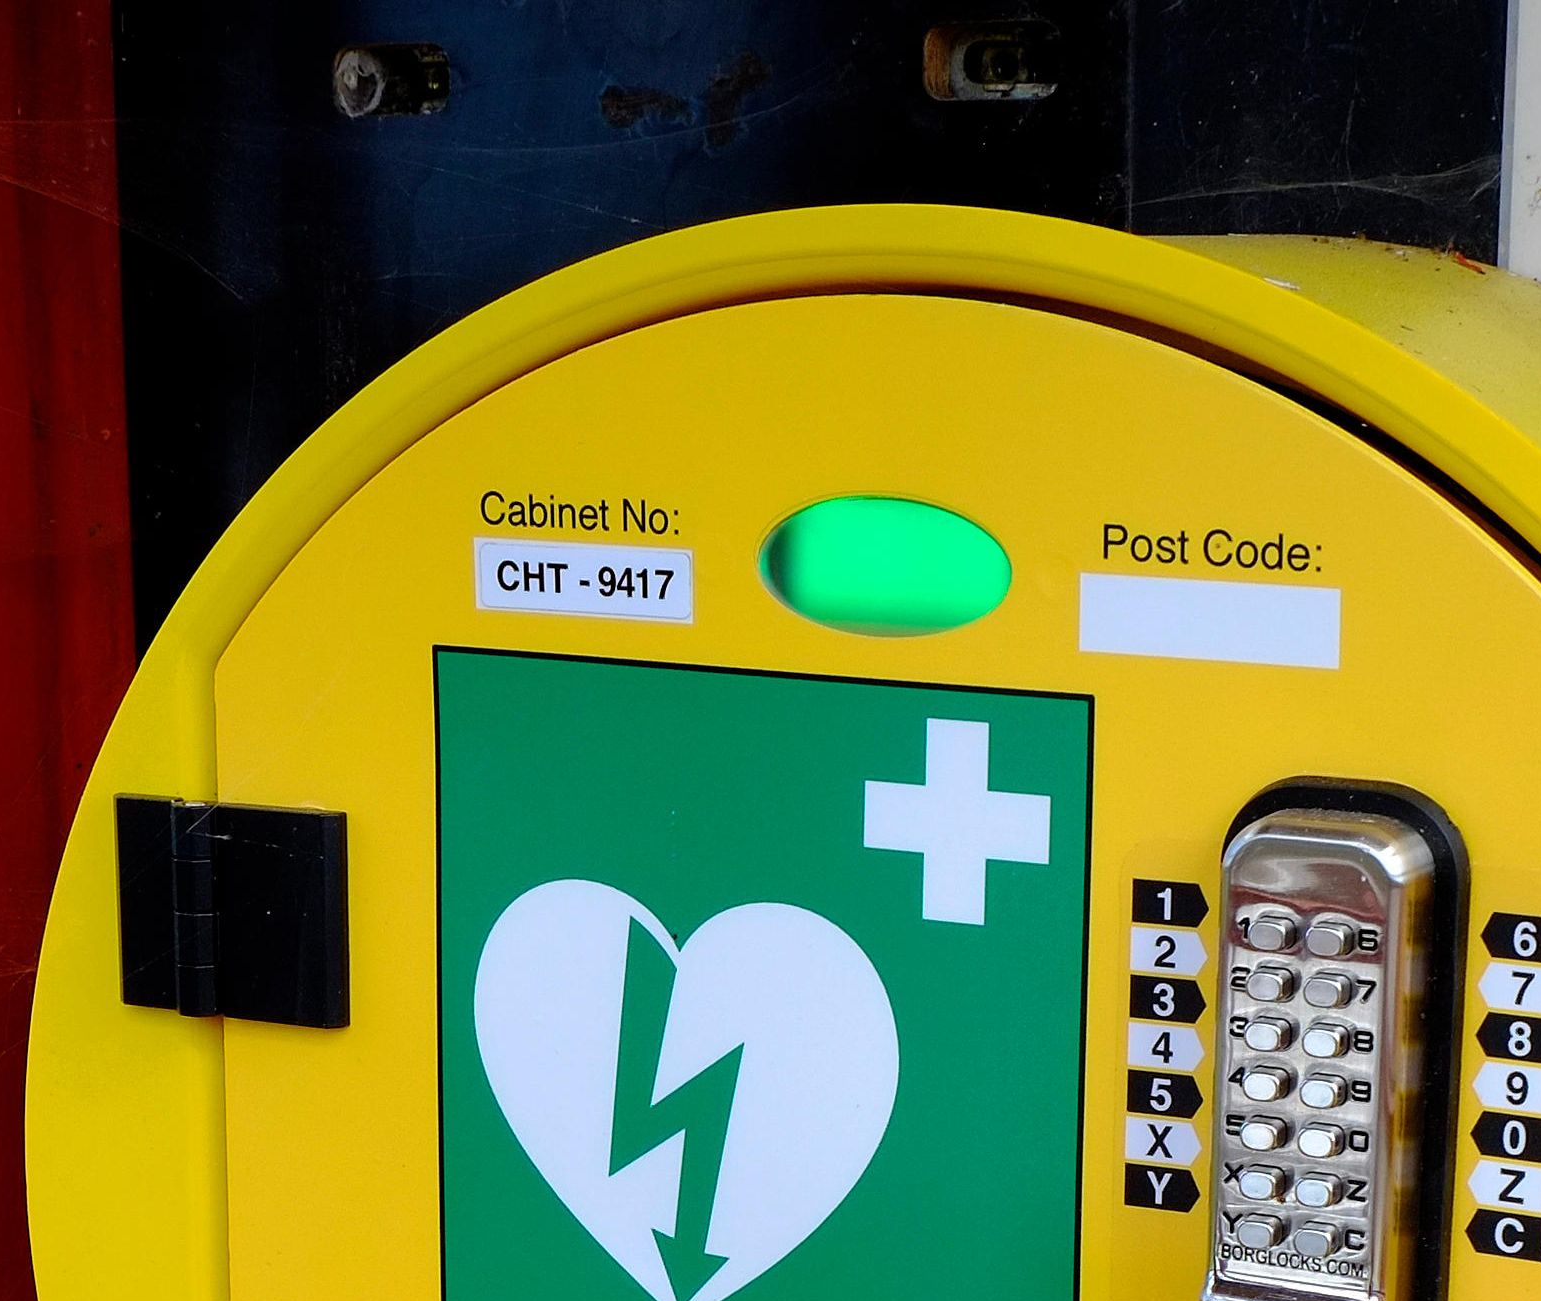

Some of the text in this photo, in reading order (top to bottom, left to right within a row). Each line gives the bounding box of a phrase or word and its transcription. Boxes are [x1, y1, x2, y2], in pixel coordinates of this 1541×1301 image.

[480, 493, 681, 536] Cabinet No:
[1103, 524, 1324, 573] Post Code:
[496, 561, 567, 596] CHT
[598, 566, 674, 600] 9417
[1158, 888, 1172, 920] 1
[1238, 917, 1250, 939] 1
[1358, 928, 1378, 951] 6
[1513, 922, 1537, 957] 6
[1154, 936, 1175, 968] 2
[1231, 966, 1250, 989] 2
[1355, 979, 1377, 1003] 7
[1512, 972, 1535, 1006] 7
[1153, 983, 1175, 1016] 3
[1230, 1016, 1248, 1038] 3
[1354, 1031, 1374, 1053] 8
[1508, 1023, 1532, 1057] 8
[1152, 1033, 1174, 1063] 4
[1228, 1066, 1245, 1087] 4
[1351, 1080, 1372, 1102] 9
[1506, 1072, 1528, 1106] 9
[1151, 1079, 1172, 1110] 5
[1226, 1114, 1245, 1136] 5
[1147, 1125, 1172, 1158] X
[1147, 1173, 1172, 1205] Y
[1224, 1163, 1244, 1184] X
[1498, 1170, 1526, 1204] Z
[1346, 1179, 1368, 1202] Z
[1223, 1211, 1243, 1233] Y
[1494, 1220, 1525, 1254] C
[1345, 1229, 1365, 1250] C
